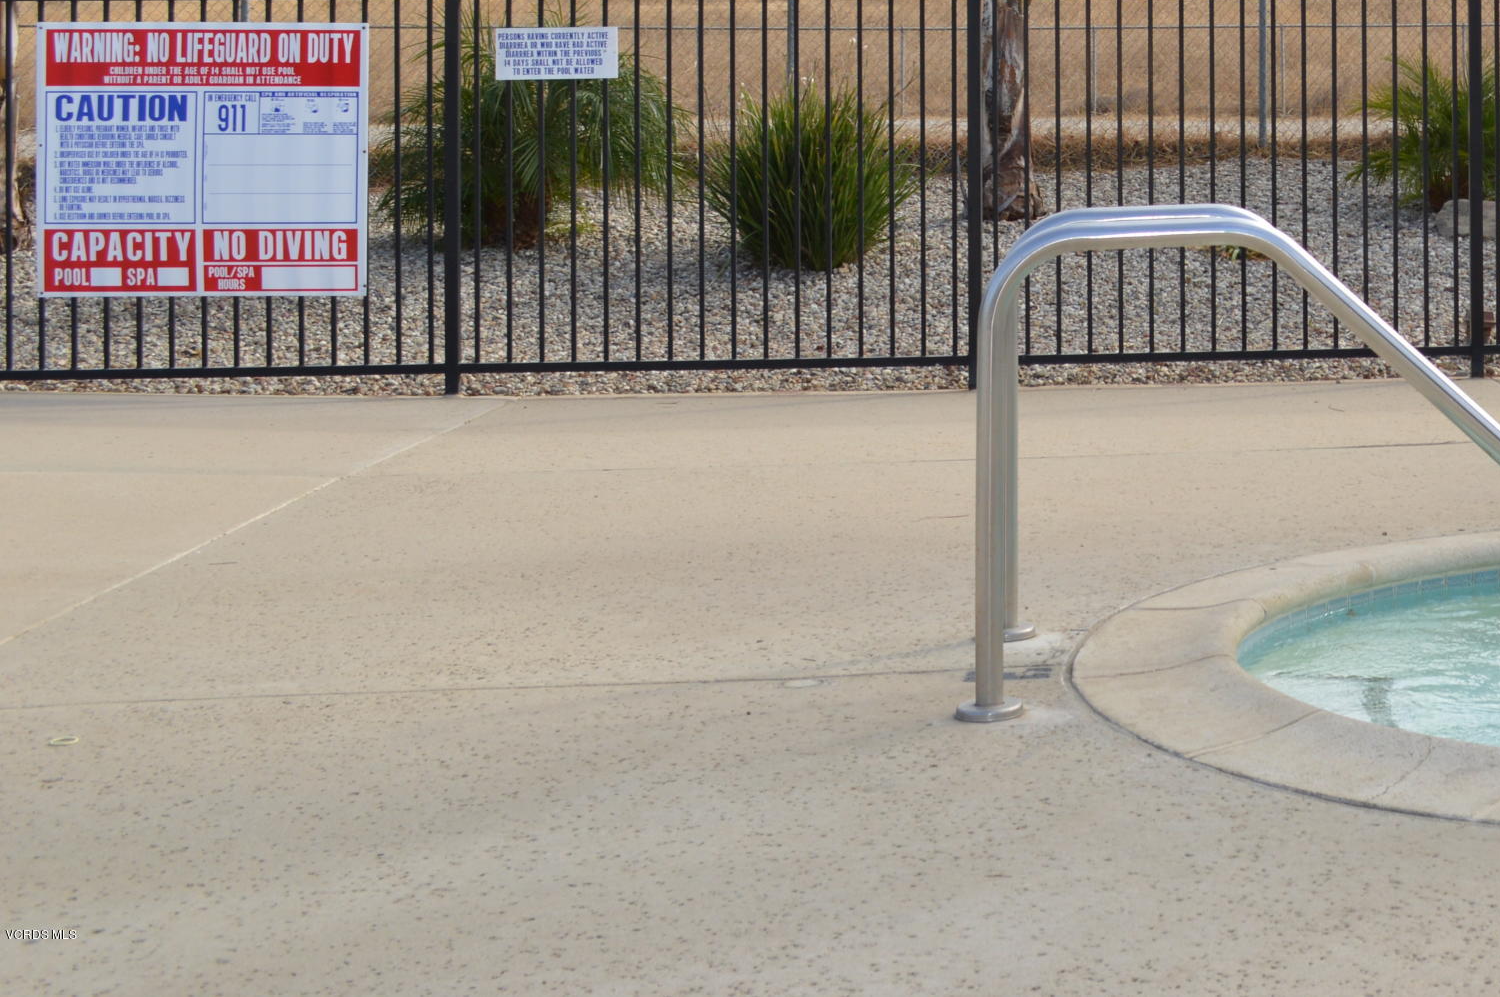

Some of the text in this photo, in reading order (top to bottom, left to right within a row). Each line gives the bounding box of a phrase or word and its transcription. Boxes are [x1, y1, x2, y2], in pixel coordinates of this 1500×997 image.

[53, 32, 355, 63] WARNING: NO LIFEGUARD ON DUTY
[109, 66, 295, 75] CHILDREN UNDER THE AGE OF 14 SHALL NOT USE POOL
[56, 94, 187, 122] CAUTION
[218, 104, 246, 132] 911
[52, 231, 191, 261] CAPACITY
[213, 231, 348, 260] NO DIVING
[54, 268, 155, 286] POOL SPA
[208, 266, 255, 278] POOL/SPA
[217, 279, 246, 290] HOURS
